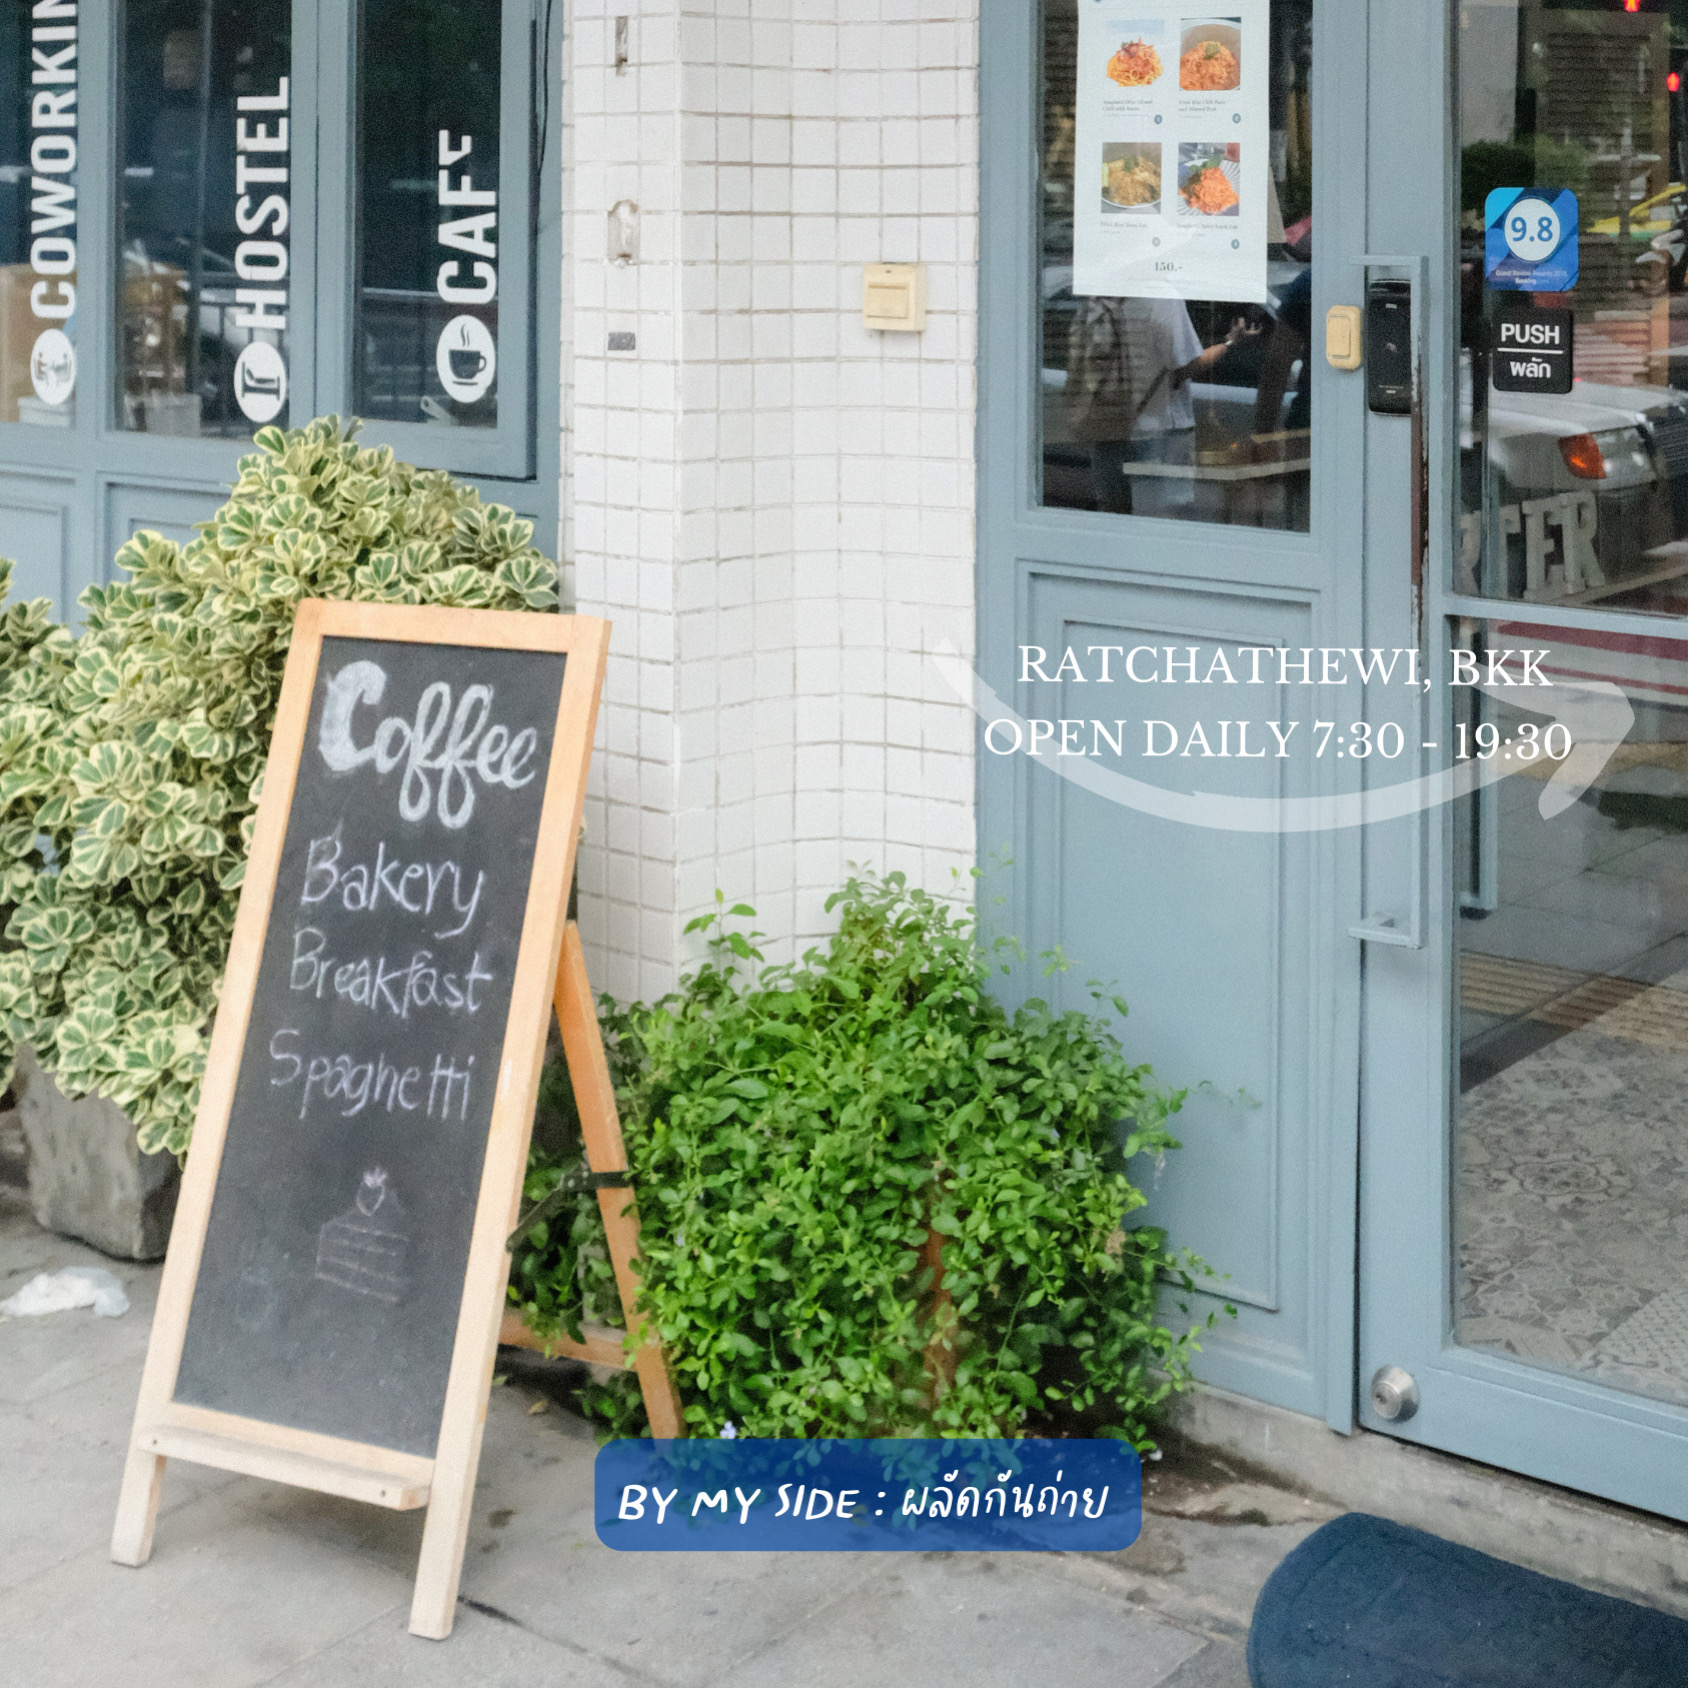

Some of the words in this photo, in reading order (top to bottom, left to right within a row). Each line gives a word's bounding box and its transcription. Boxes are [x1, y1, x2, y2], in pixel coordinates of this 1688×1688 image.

[235, 76, 289, 329] HOSTEL
[1510, 216, 1554, 242] 9.8
[1500, 323, 1560, 345] PUSH
[318, 660, 538, 829] Coffee
[301, 836, 485, 939] Bakery
[290, 926, 493, 1018] Breakfast
[269, 1028, 475, 1121] Spaghetti
